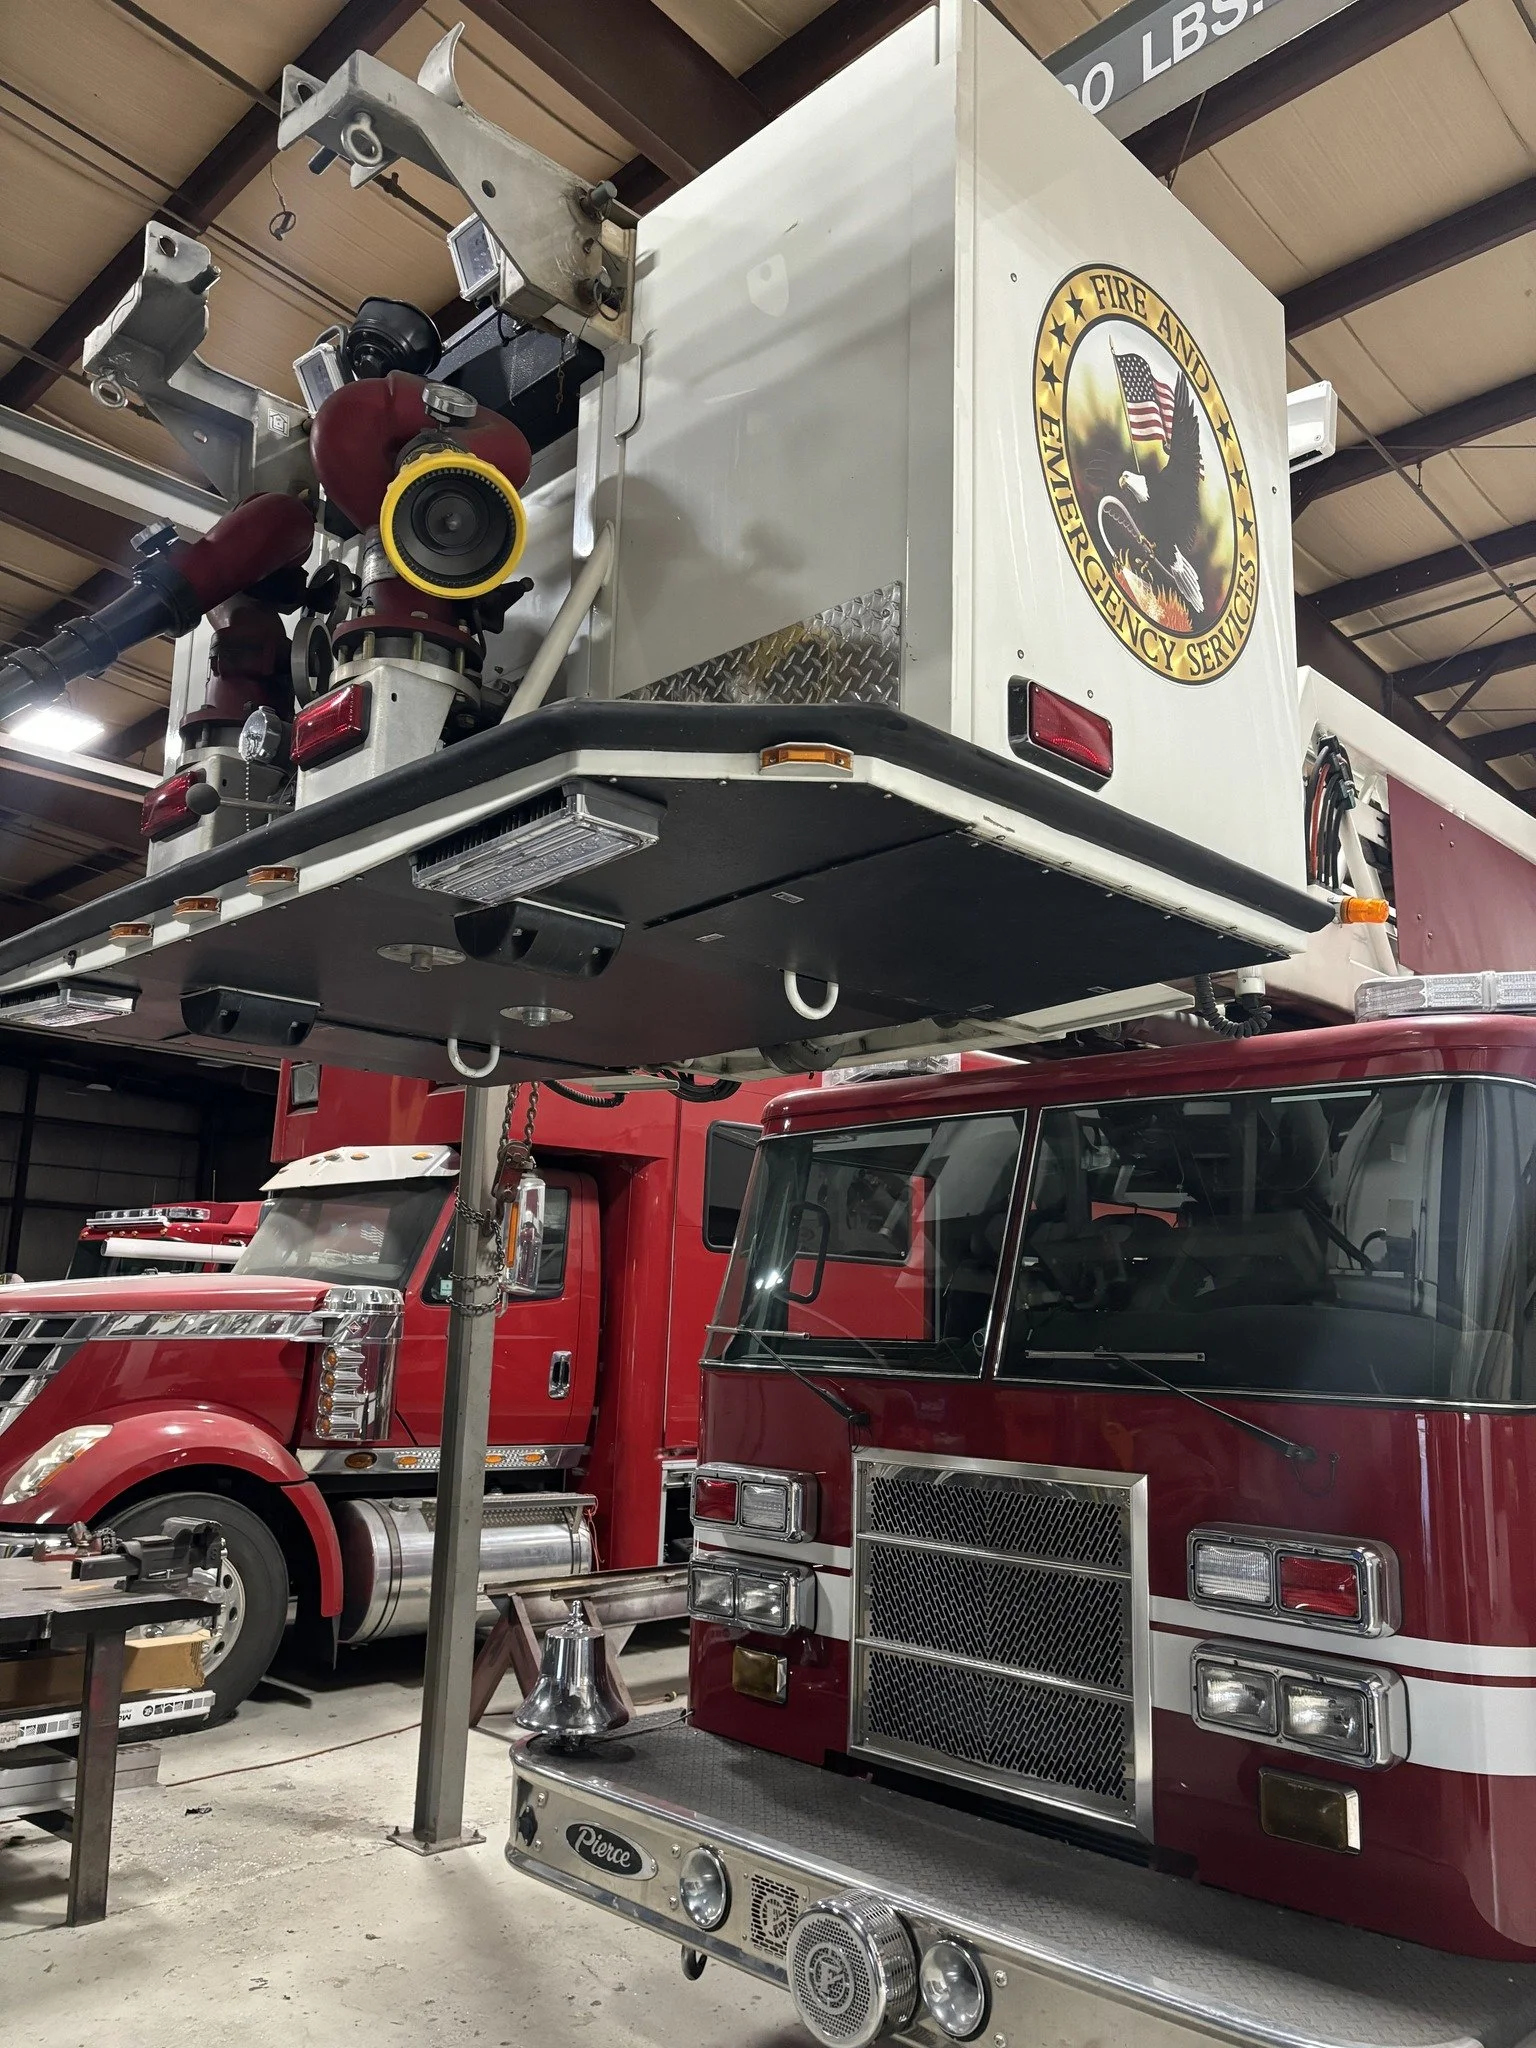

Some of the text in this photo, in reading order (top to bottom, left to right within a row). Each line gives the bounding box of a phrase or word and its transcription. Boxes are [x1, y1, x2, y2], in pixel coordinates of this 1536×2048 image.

[1089, 274, 1209, 394] FIRE AND
[1040, 410, 1256, 676] EMERGENCY SERVICES
[574, 1826, 631, 1868] Pierce
